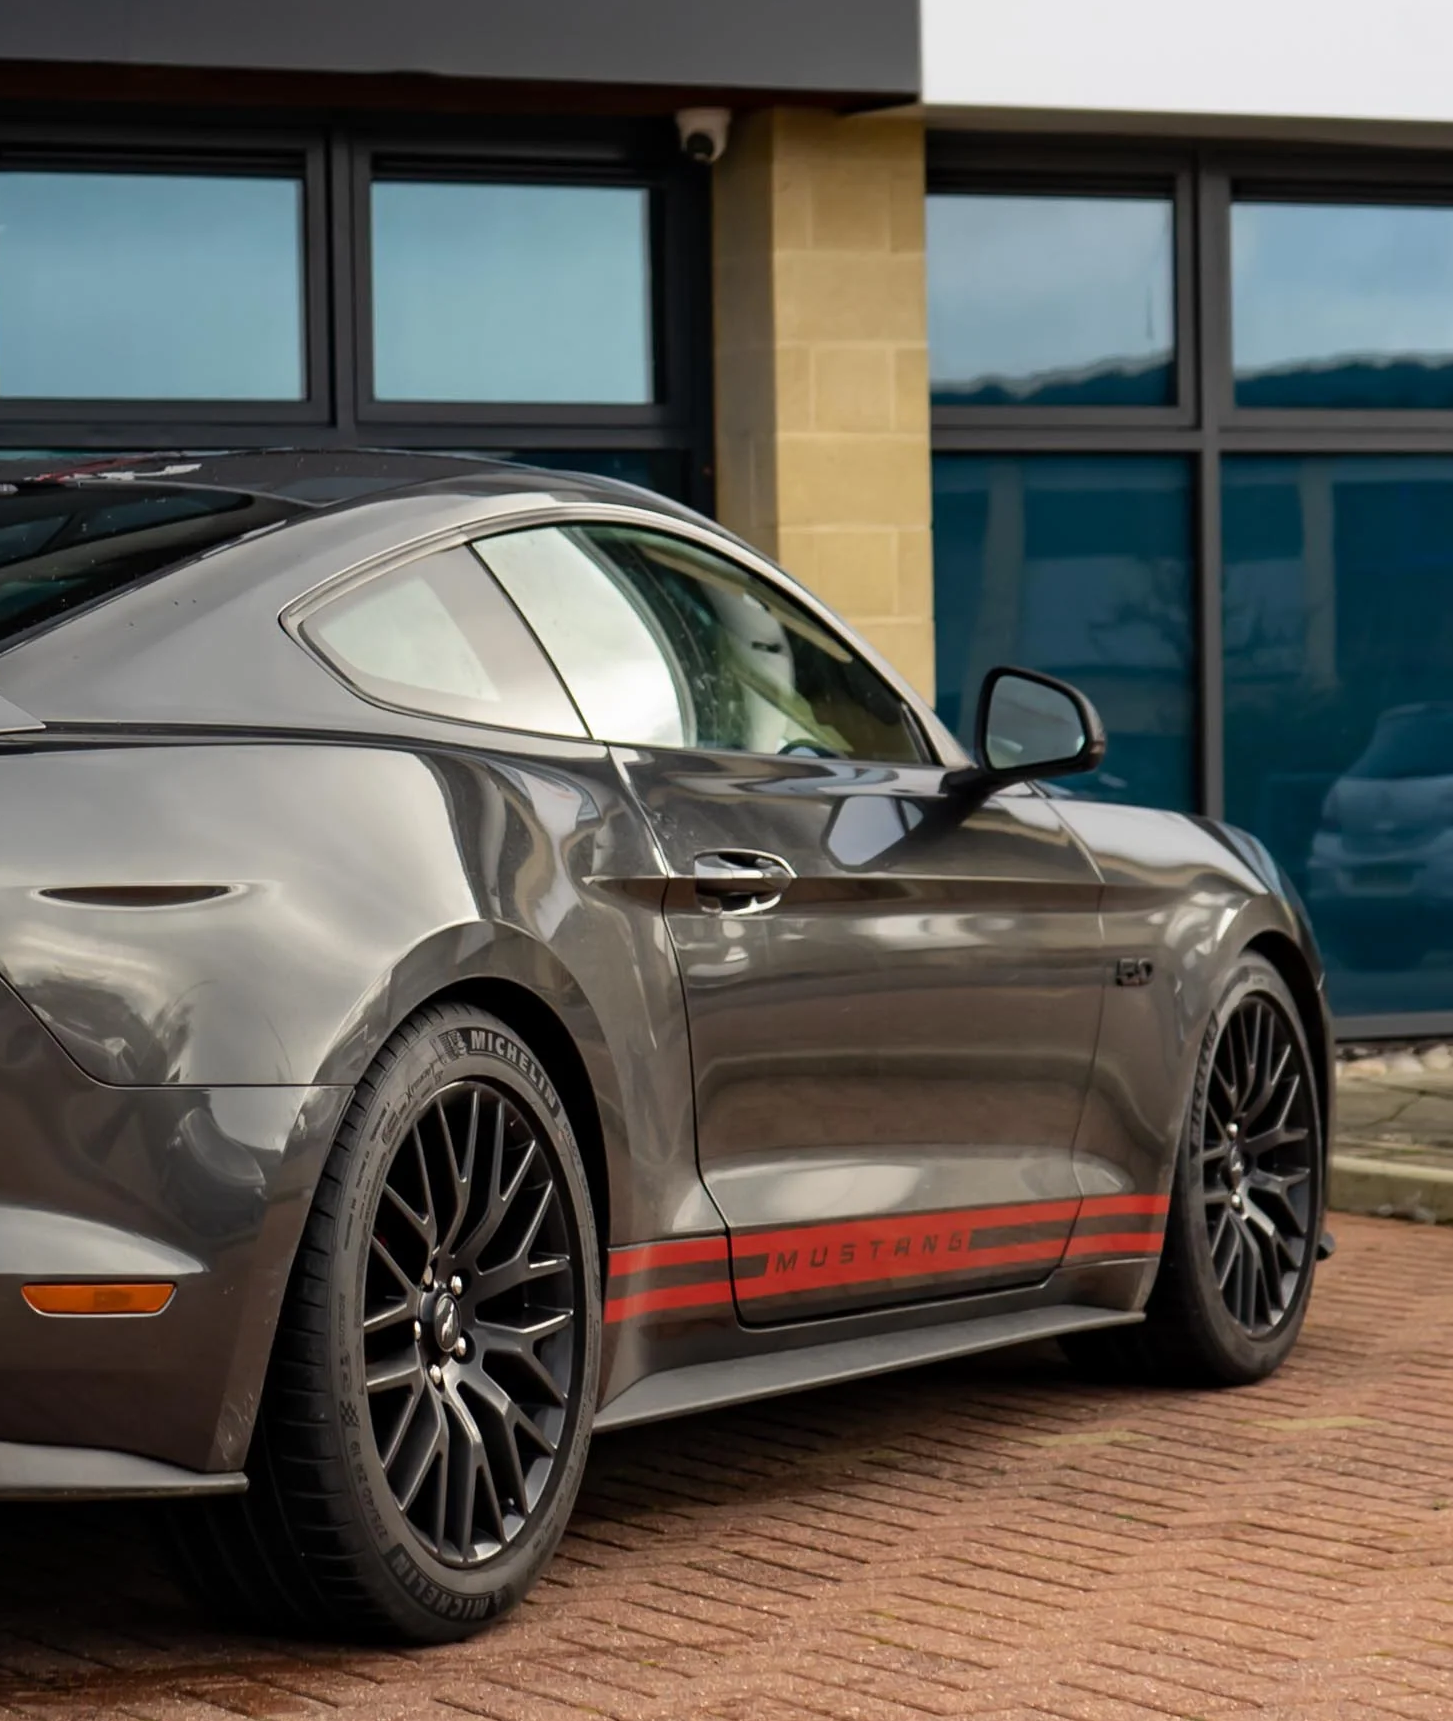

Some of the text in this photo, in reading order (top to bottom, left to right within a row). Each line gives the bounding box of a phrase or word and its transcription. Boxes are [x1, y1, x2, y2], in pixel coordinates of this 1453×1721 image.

[470, 1030, 557, 1108] MICHELIN
[774, 1231, 964, 1275] MUSTANG
[391, 1552, 490, 1619] MICHELIN
